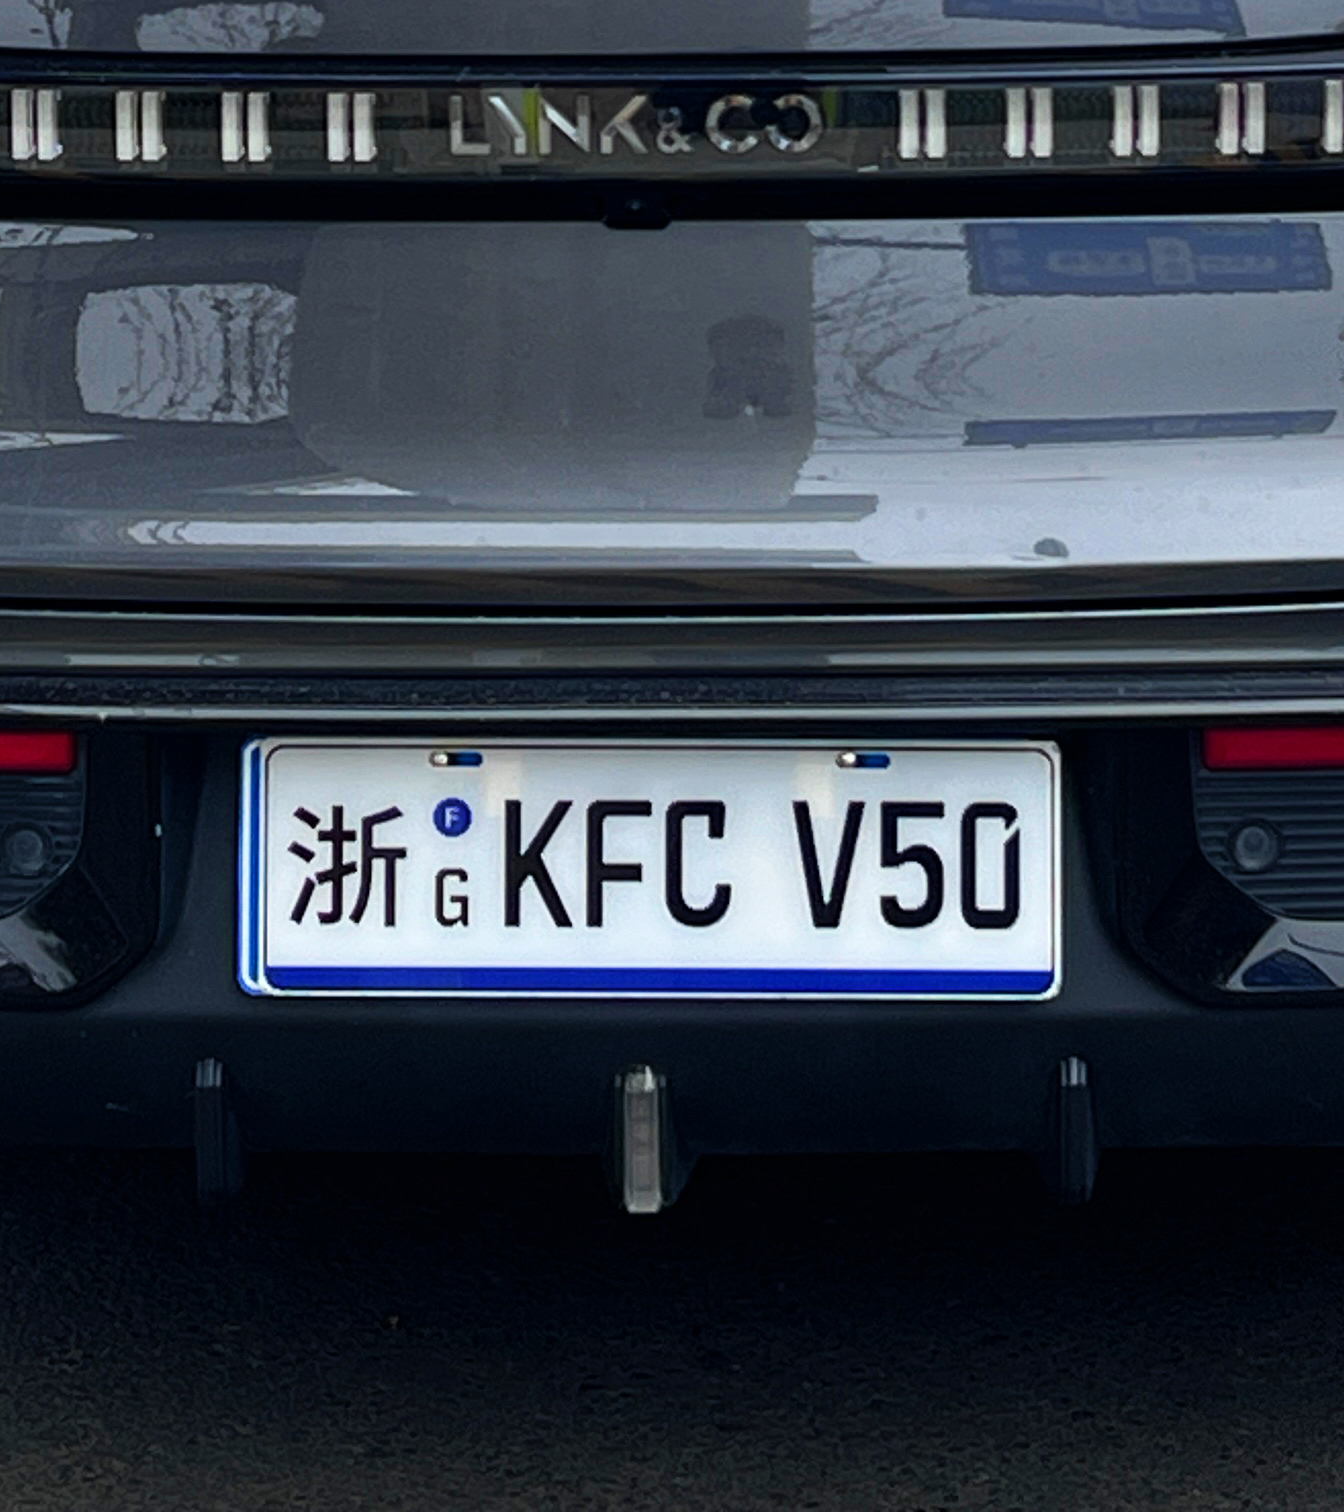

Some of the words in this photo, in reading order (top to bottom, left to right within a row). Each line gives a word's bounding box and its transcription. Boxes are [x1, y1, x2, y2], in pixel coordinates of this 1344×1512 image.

[287, 804, 407, 927] 浙
[435, 867, 469, 927] G
[505, 800, 731, 928] KFC
[792, 800, 1020, 929] V50
